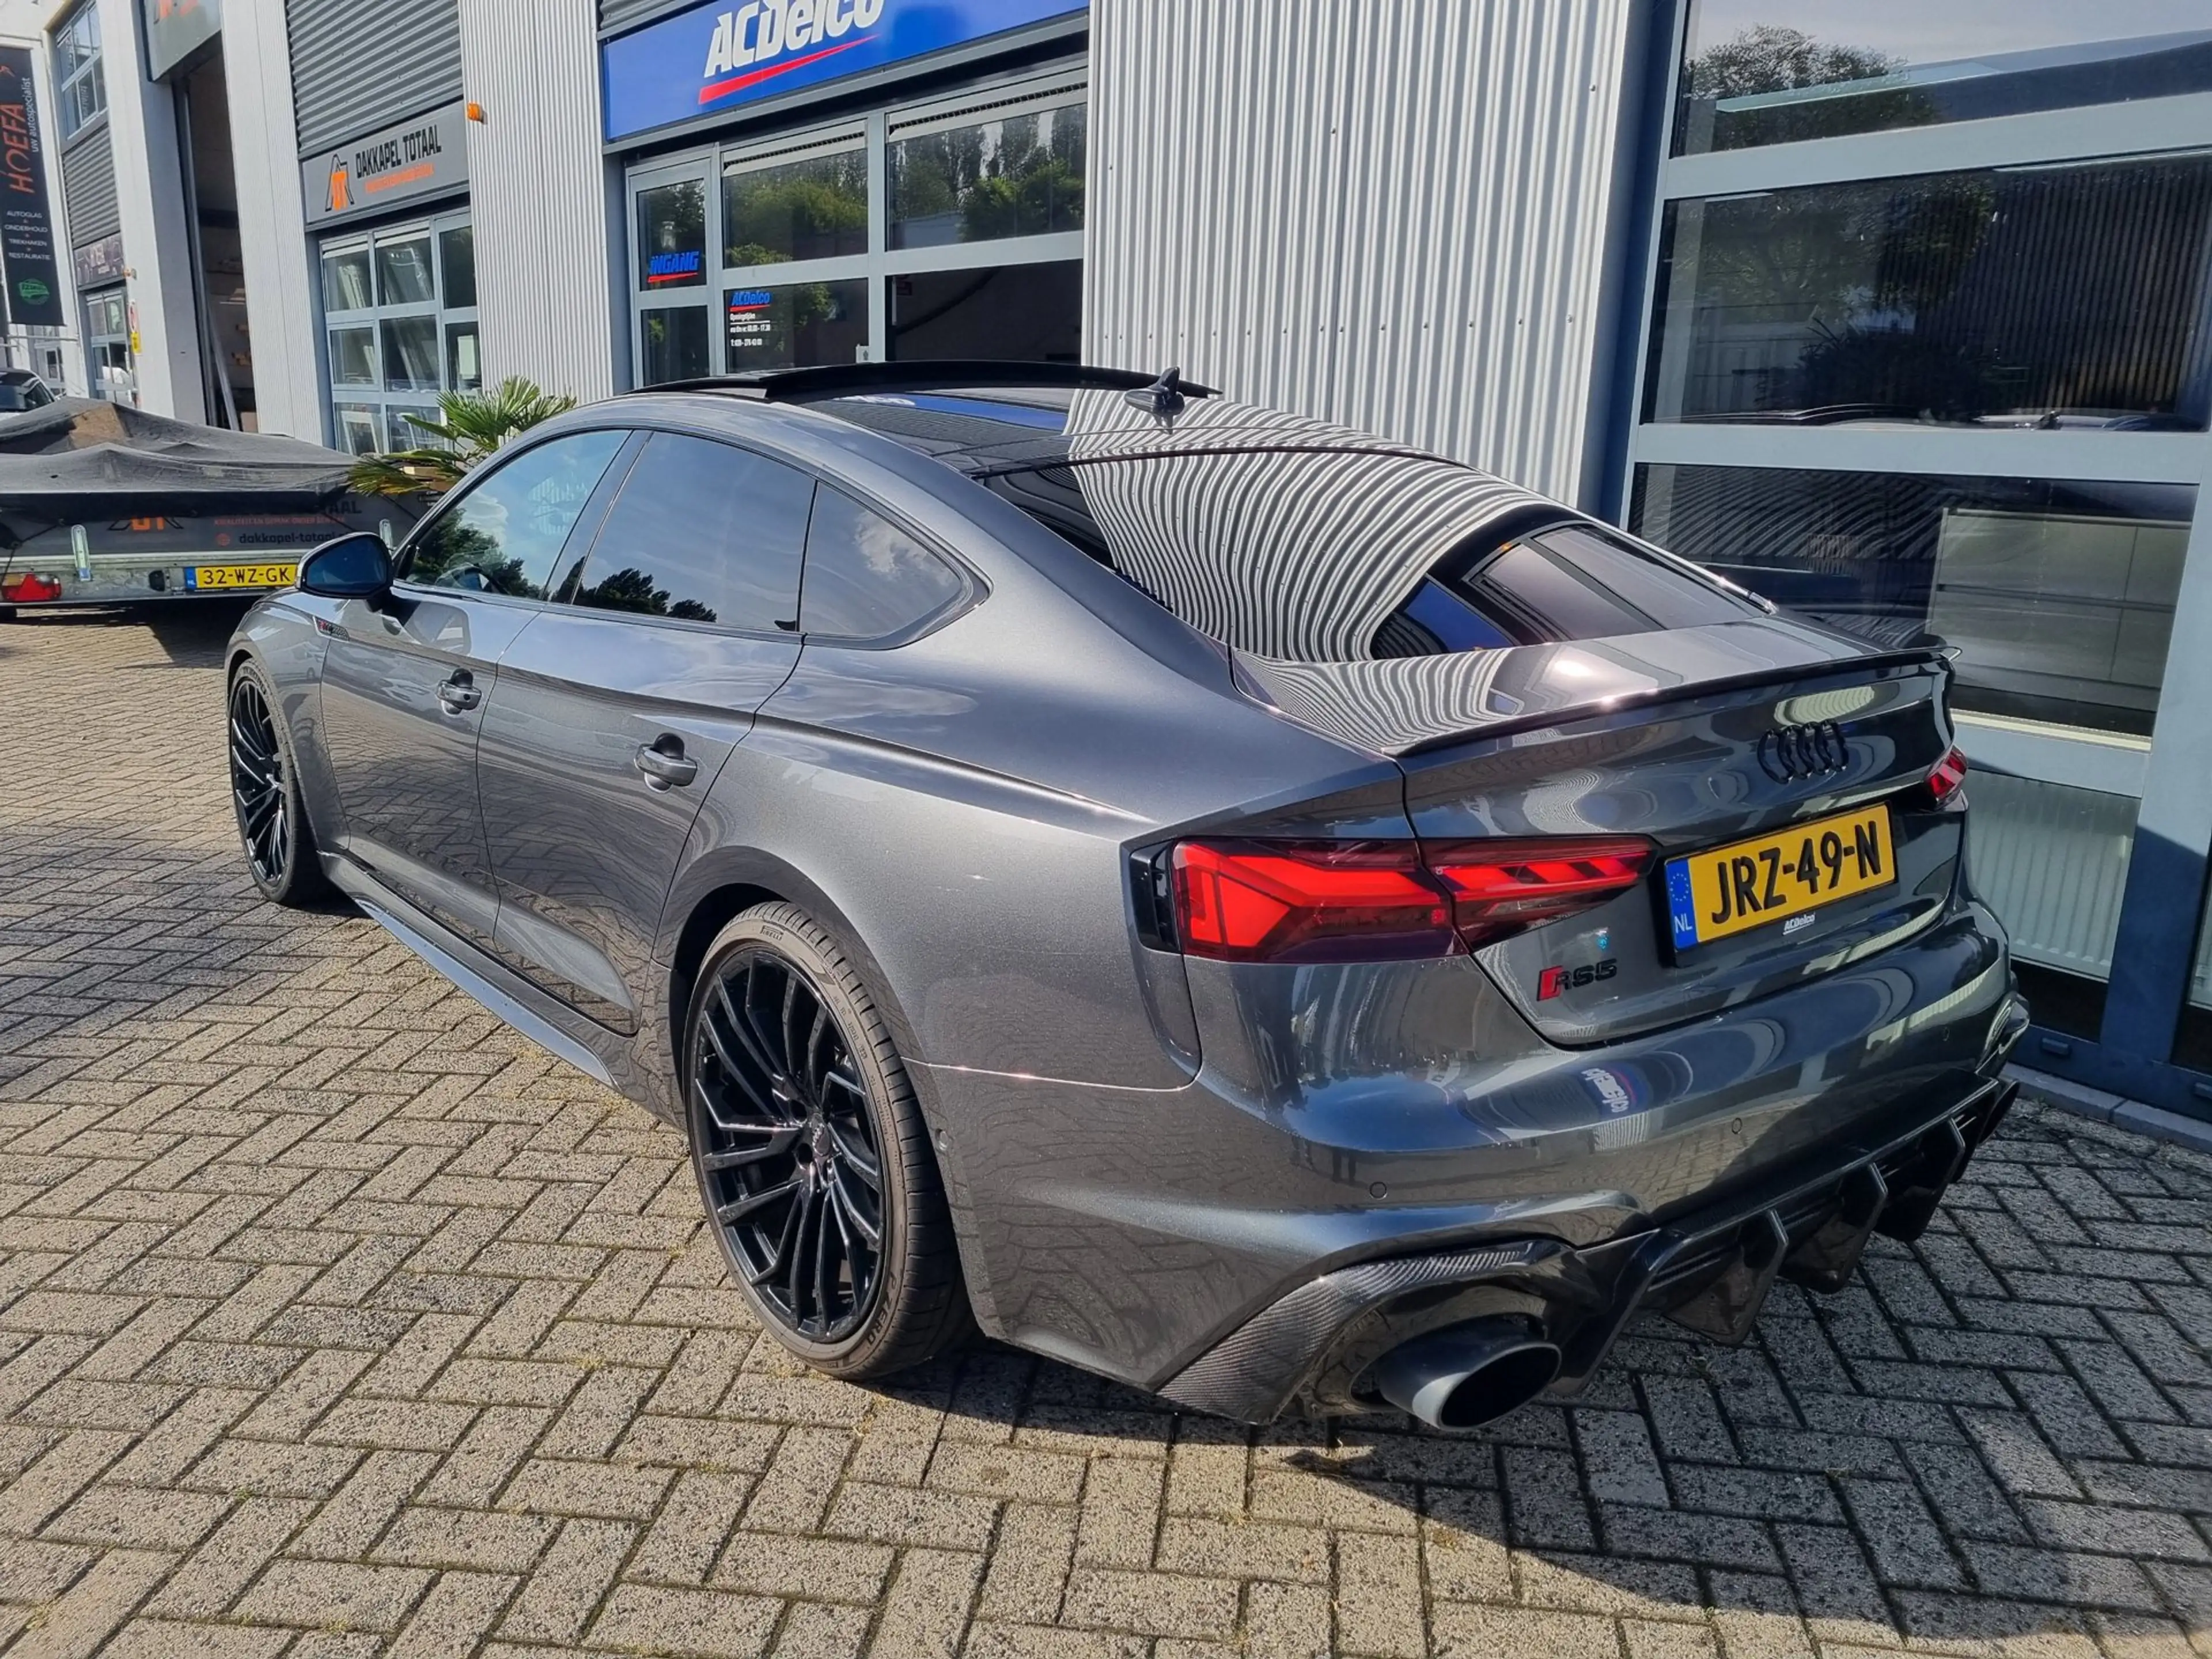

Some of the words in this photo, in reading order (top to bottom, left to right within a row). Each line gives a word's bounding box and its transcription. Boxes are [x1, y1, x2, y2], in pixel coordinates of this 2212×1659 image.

[704, 0, 884, 78] ACDelco
[0, 104, 35, 194] HOEFA
[29, 138, 39, 153] uw
[355, 139, 402, 179] DAKKAPEL
[403, 124, 442, 163] TOTAAL
[7, 210, 43, 218] AUTOGLAS
[4, 224, 48, 233] ONDERHOUD
[731, 290, 771, 306] ACDelco
[203, 567, 290, 585] 32-WZ-GK
[1711, 820, 1881, 924] JRZ-49-N
[1675, 913, 1693, 933] NL
[1783, 914, 1816, 931] ACDelco
[1544, 959, 1617, 997] RS5
[867, 1291, 893, 1345] ZERO
